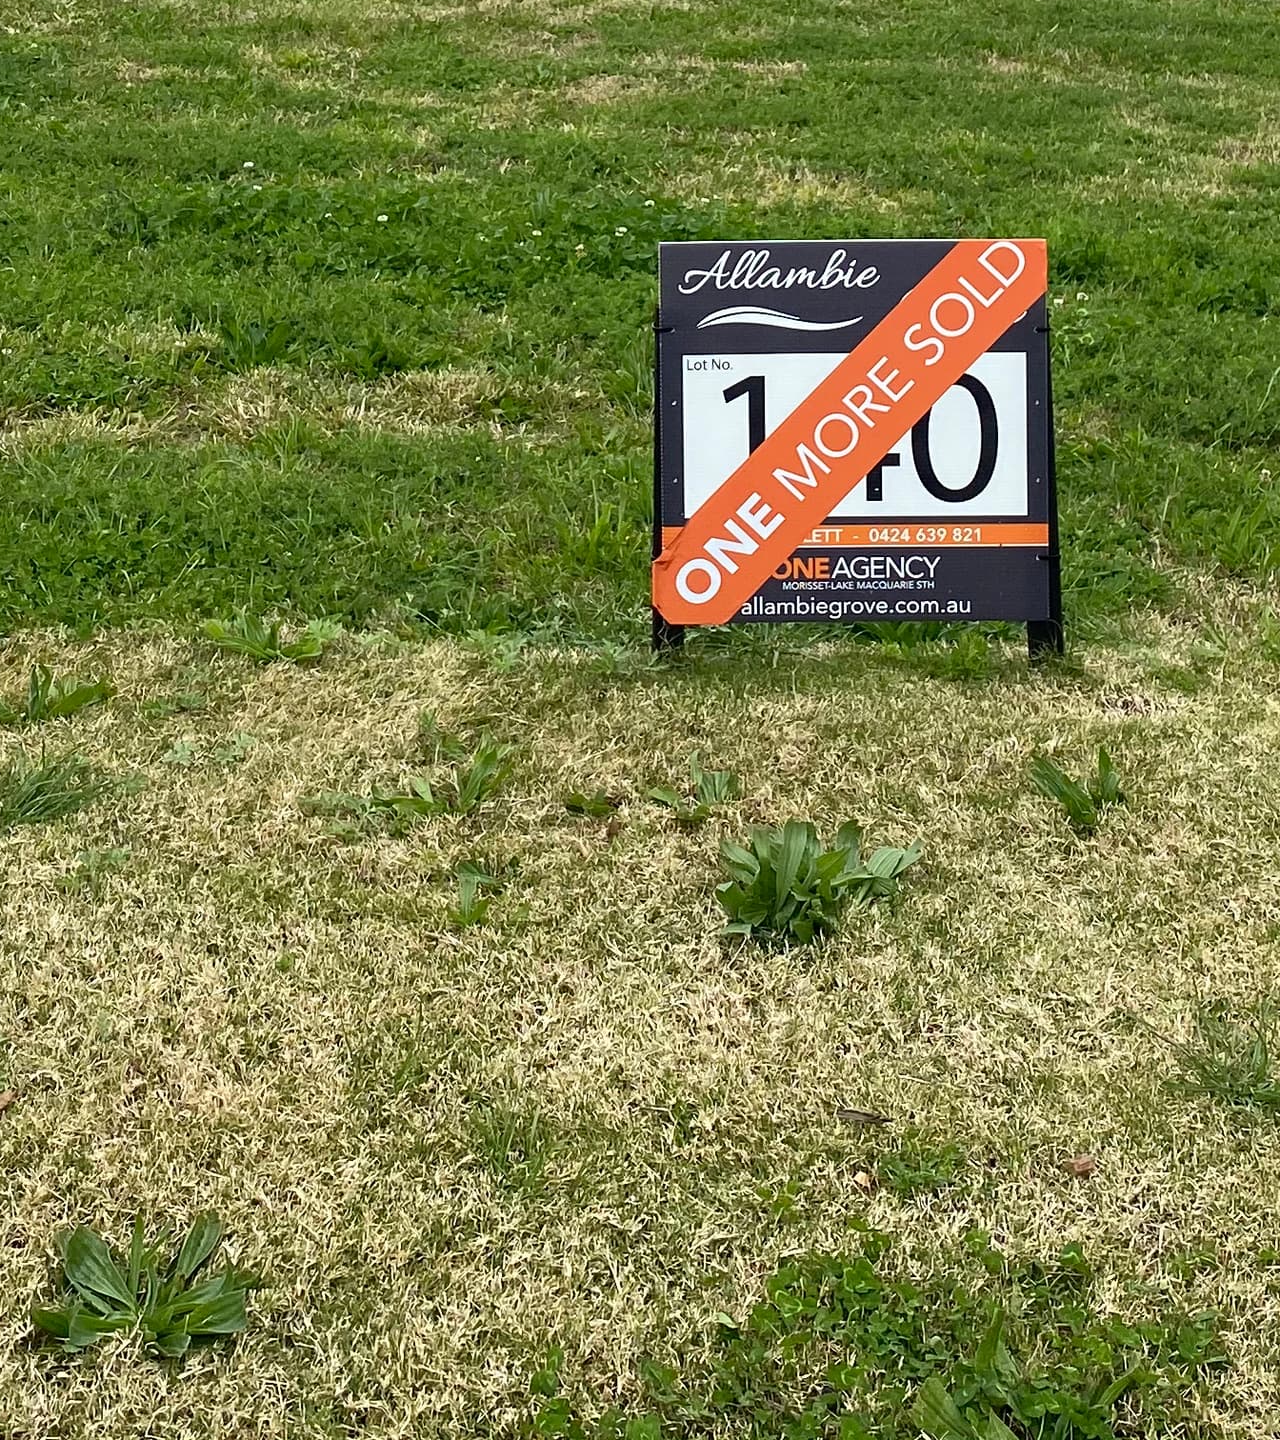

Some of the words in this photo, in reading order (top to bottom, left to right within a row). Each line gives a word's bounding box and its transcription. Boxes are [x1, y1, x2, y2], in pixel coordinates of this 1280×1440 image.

[678, 249, 880, 294] Allambie
[686, 358, 707, 371] Lot
[711, 358, 733, 371] No.
[675, 492, 786, 605] ONE
[772, 356, 915, 502] MORE
[904, 240, 1026, 365] SOLD
[868, 527, 910, 542] 0424
[916, 527, 947, 542] 639
[952, 527, 981, 542] 821
[782, 580, 854, 590] MORISSET-LAKE
[856, 580, 914, 590] MACQUARIE
[916, 580, 935, 589] STH
[741, 596, 971, 619] allambiegrove.com.au
